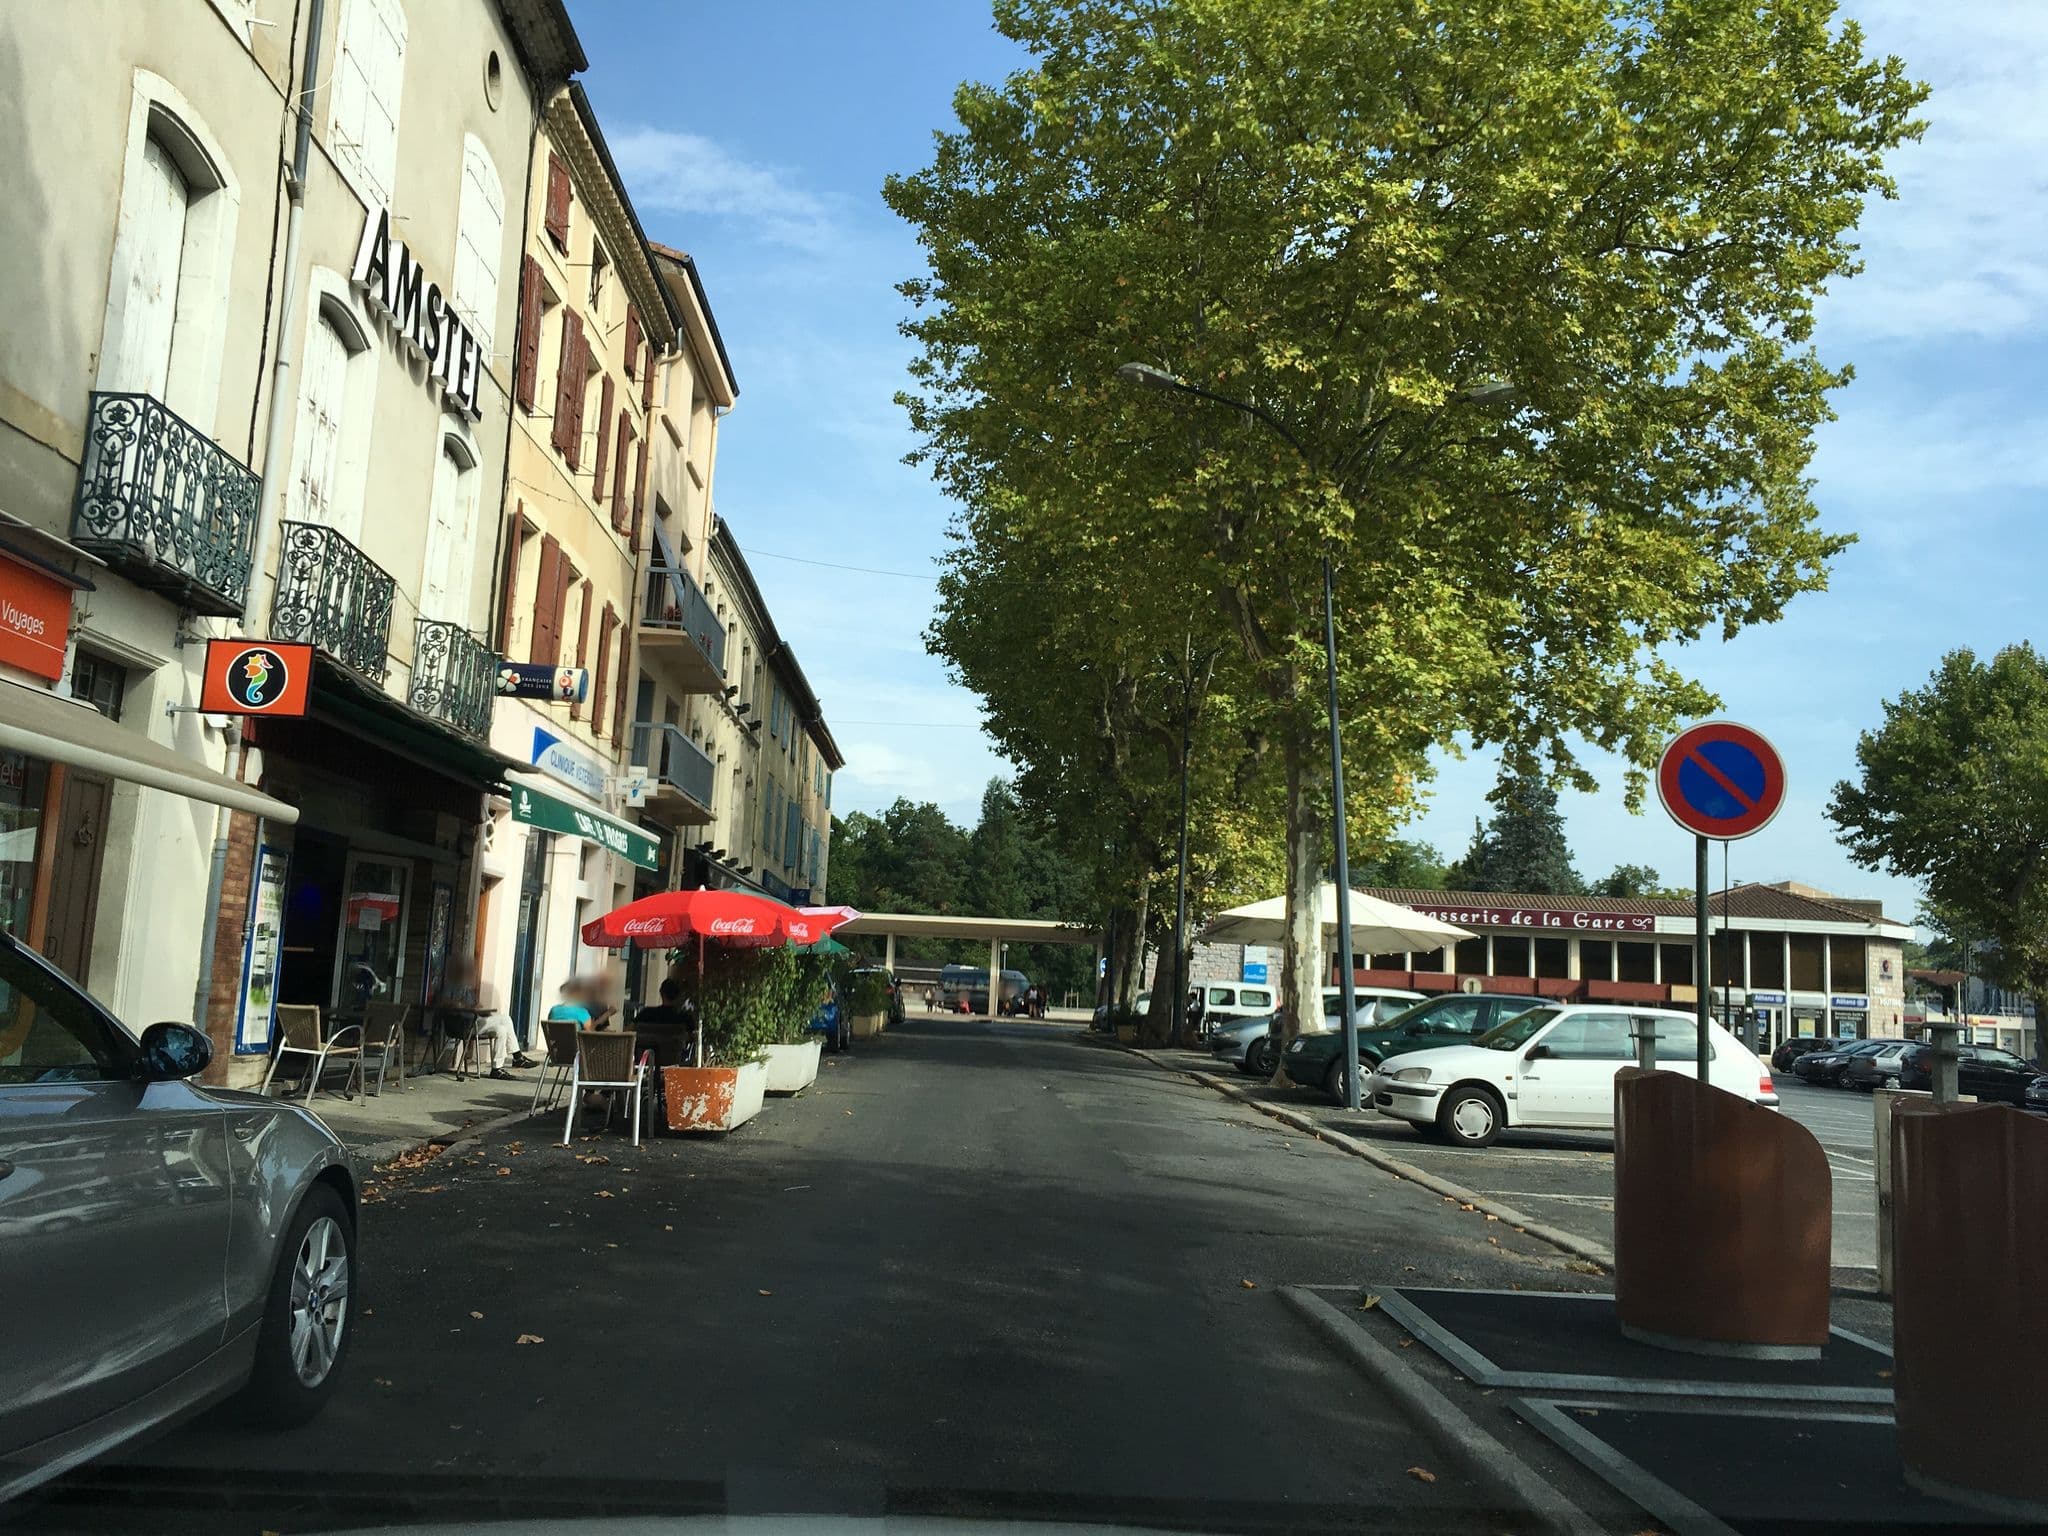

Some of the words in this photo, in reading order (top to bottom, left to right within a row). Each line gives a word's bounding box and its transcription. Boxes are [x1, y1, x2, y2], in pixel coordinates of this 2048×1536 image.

[353, 206, 482, 423] AMSTEL
[2, 600, 45, 635] Voyages
[550, 749, 575, 777] CLINIQUE
[1511, 911, 1532, 926] de
[1543, 912, 1561, 927] la
[1573, 912, 1625, 929] Gare
